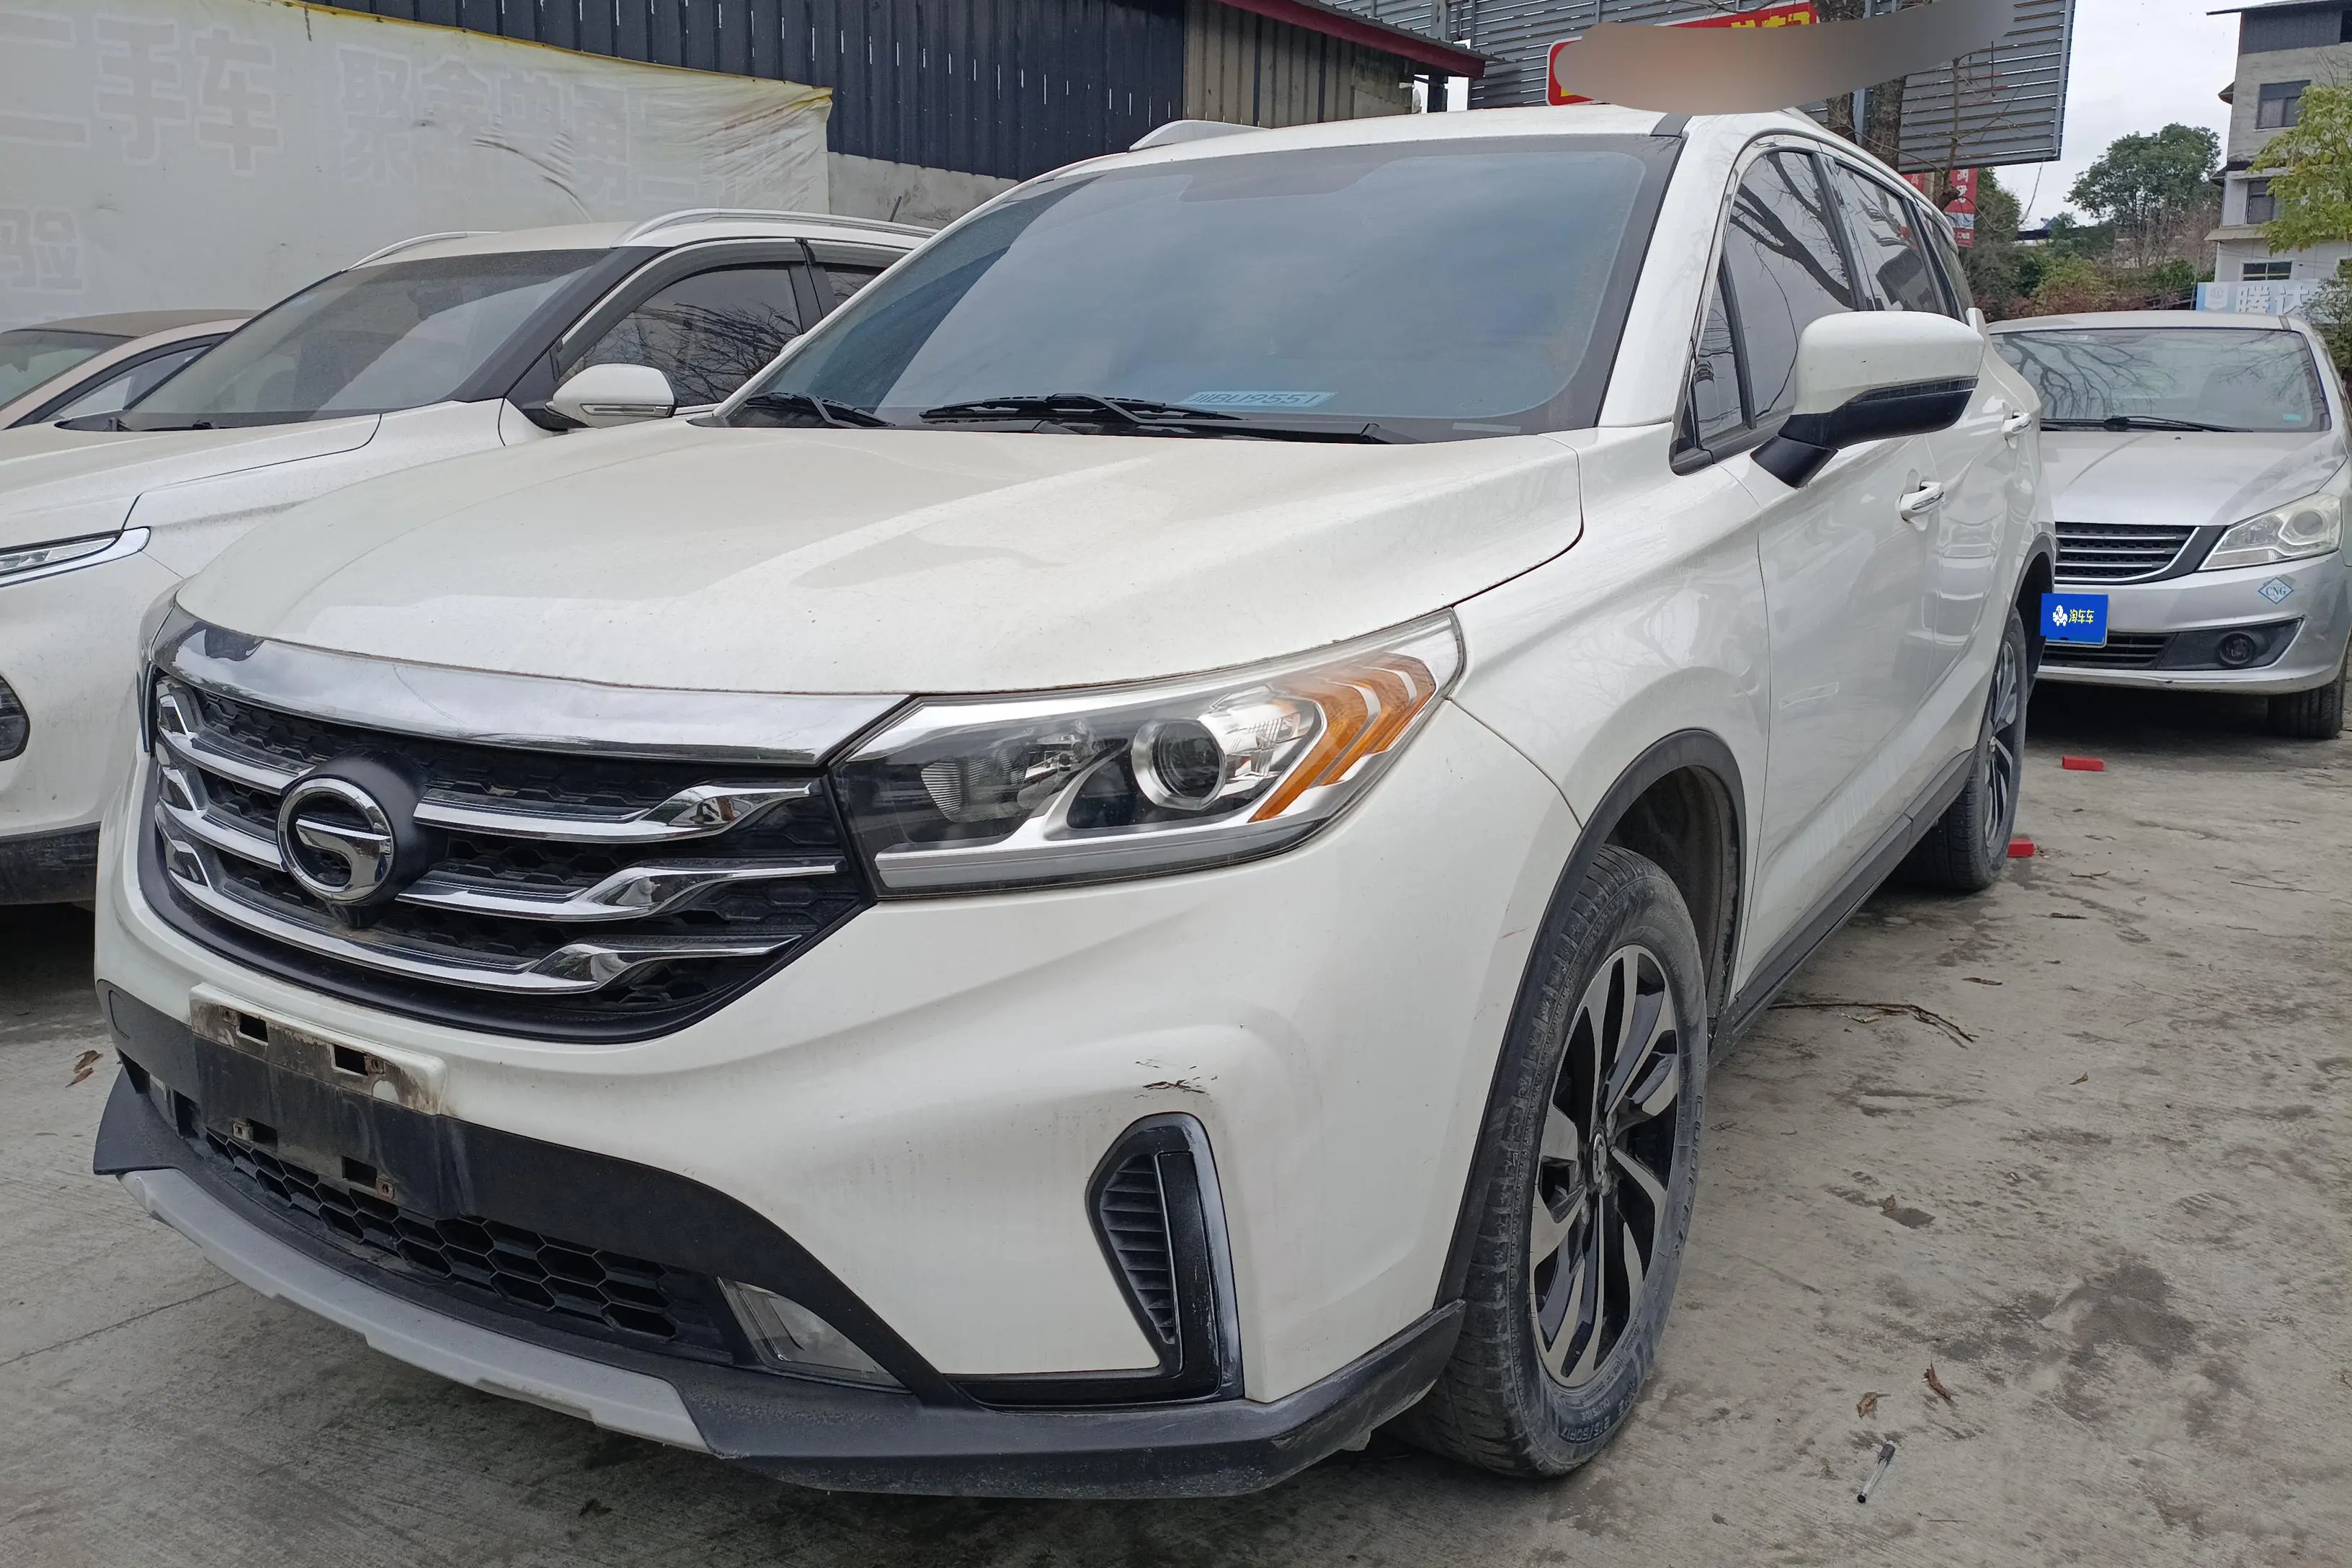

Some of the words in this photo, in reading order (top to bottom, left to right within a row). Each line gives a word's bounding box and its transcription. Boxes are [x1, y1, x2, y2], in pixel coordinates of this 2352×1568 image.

[0, 11, 284, 176] 二手车
[2266, 586, 2286, 597] CNG
[1580, 1397, 1611, 1422] OUTSIDE
